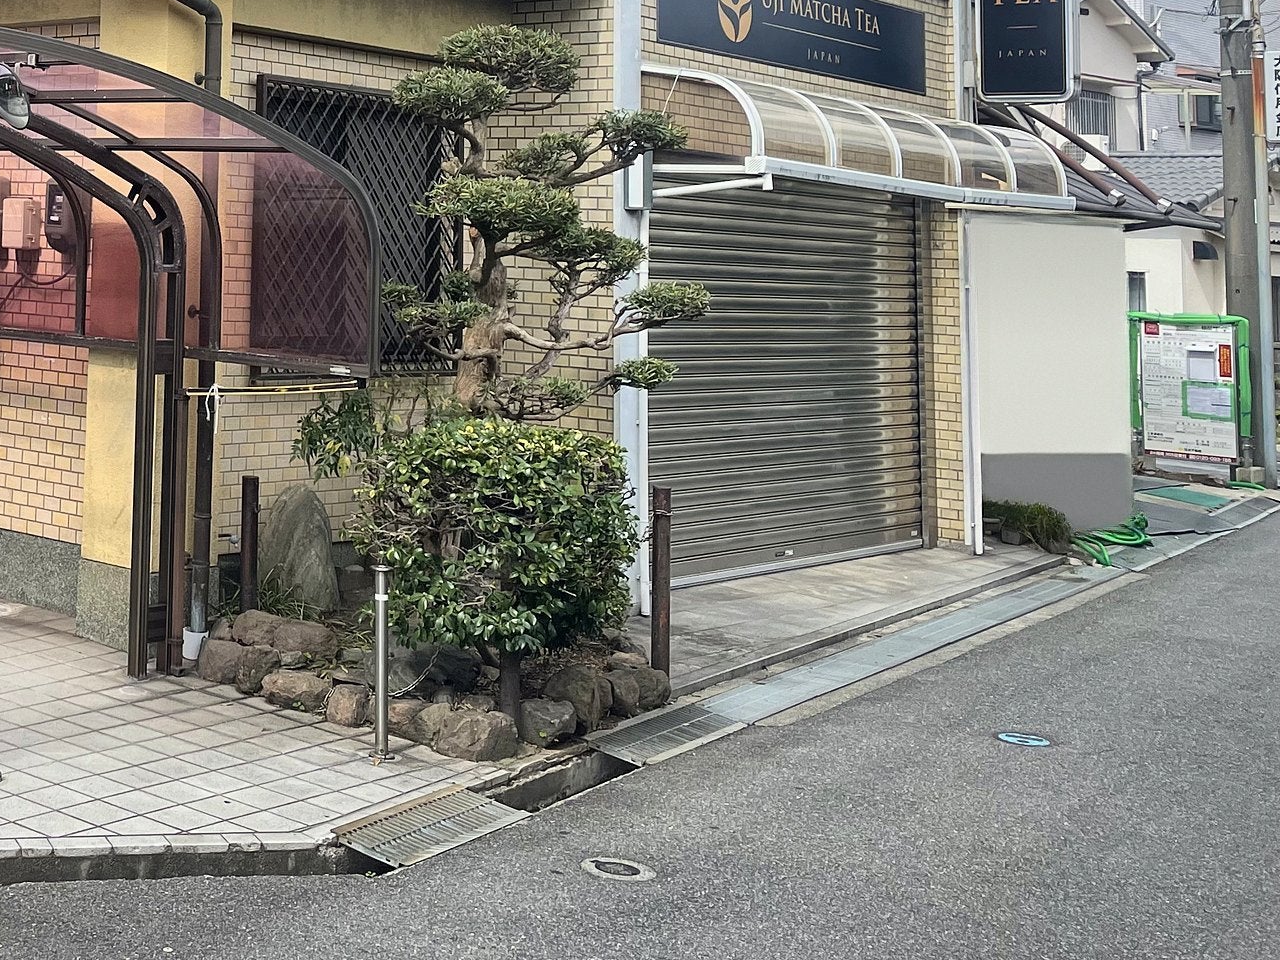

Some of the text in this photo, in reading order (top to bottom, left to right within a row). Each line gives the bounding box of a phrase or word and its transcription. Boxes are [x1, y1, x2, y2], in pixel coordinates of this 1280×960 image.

[855, 7, 880, 35] TEA
[807, 48, 840, 64] JAPAN
[998, 49, 1048, 59] JAPAN
